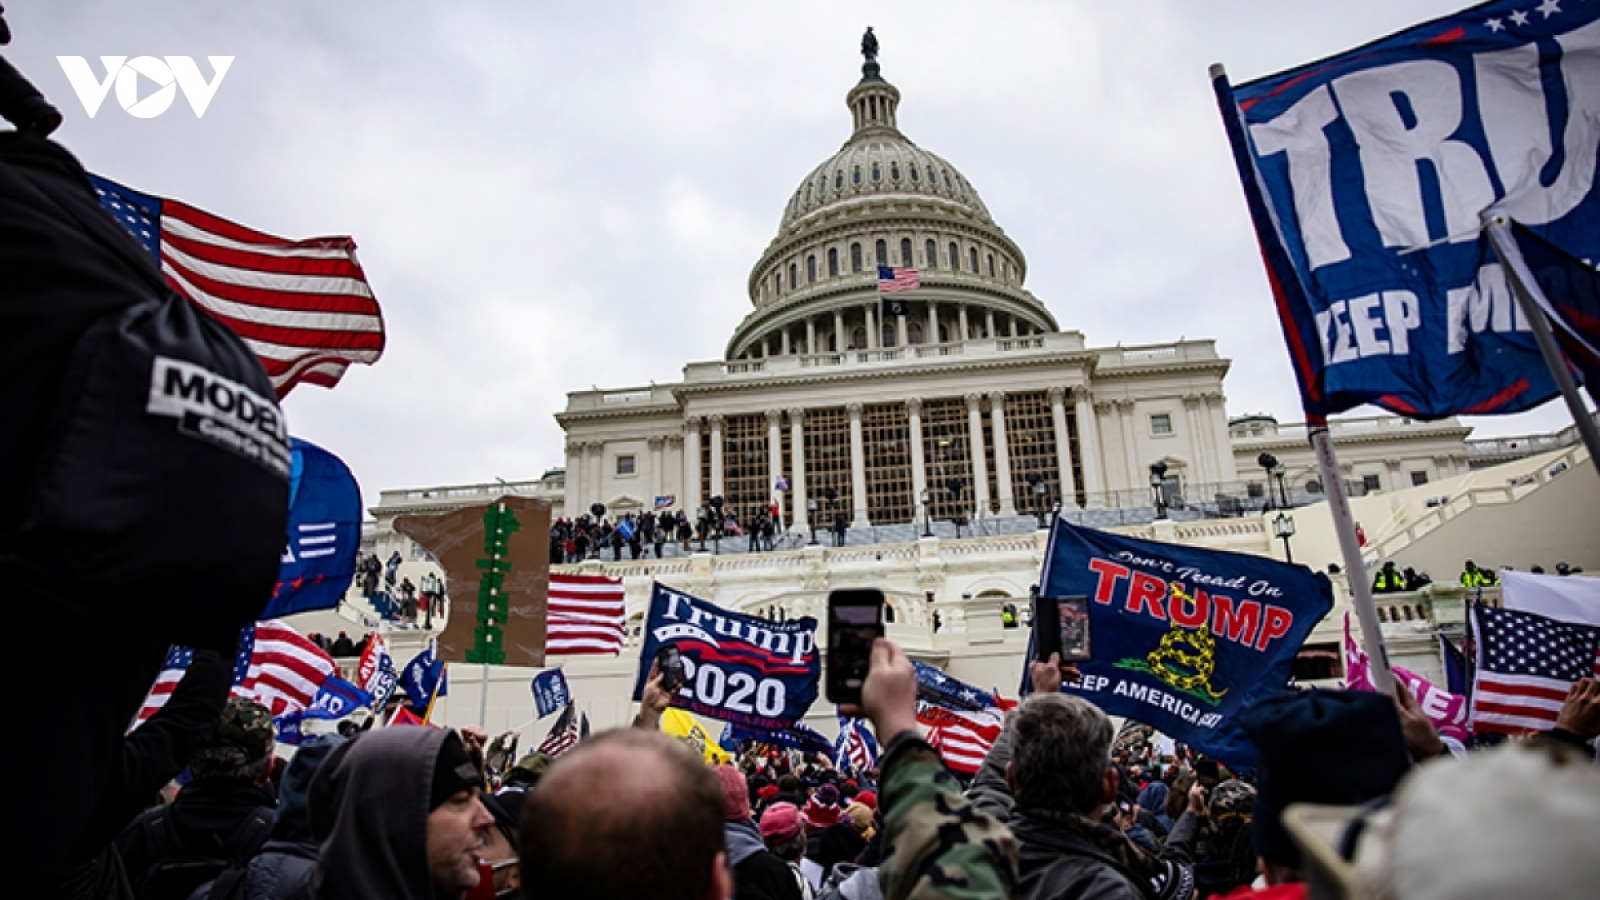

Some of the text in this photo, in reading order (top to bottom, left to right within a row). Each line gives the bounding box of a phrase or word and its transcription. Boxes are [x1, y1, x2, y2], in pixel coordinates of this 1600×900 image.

[1089, 557, 1293, 652] TRUMP
[1176, 566, 1247, 590] Tread
[1247, 580, 1284, 598] On
[659, 587, 814, 665] Trump
